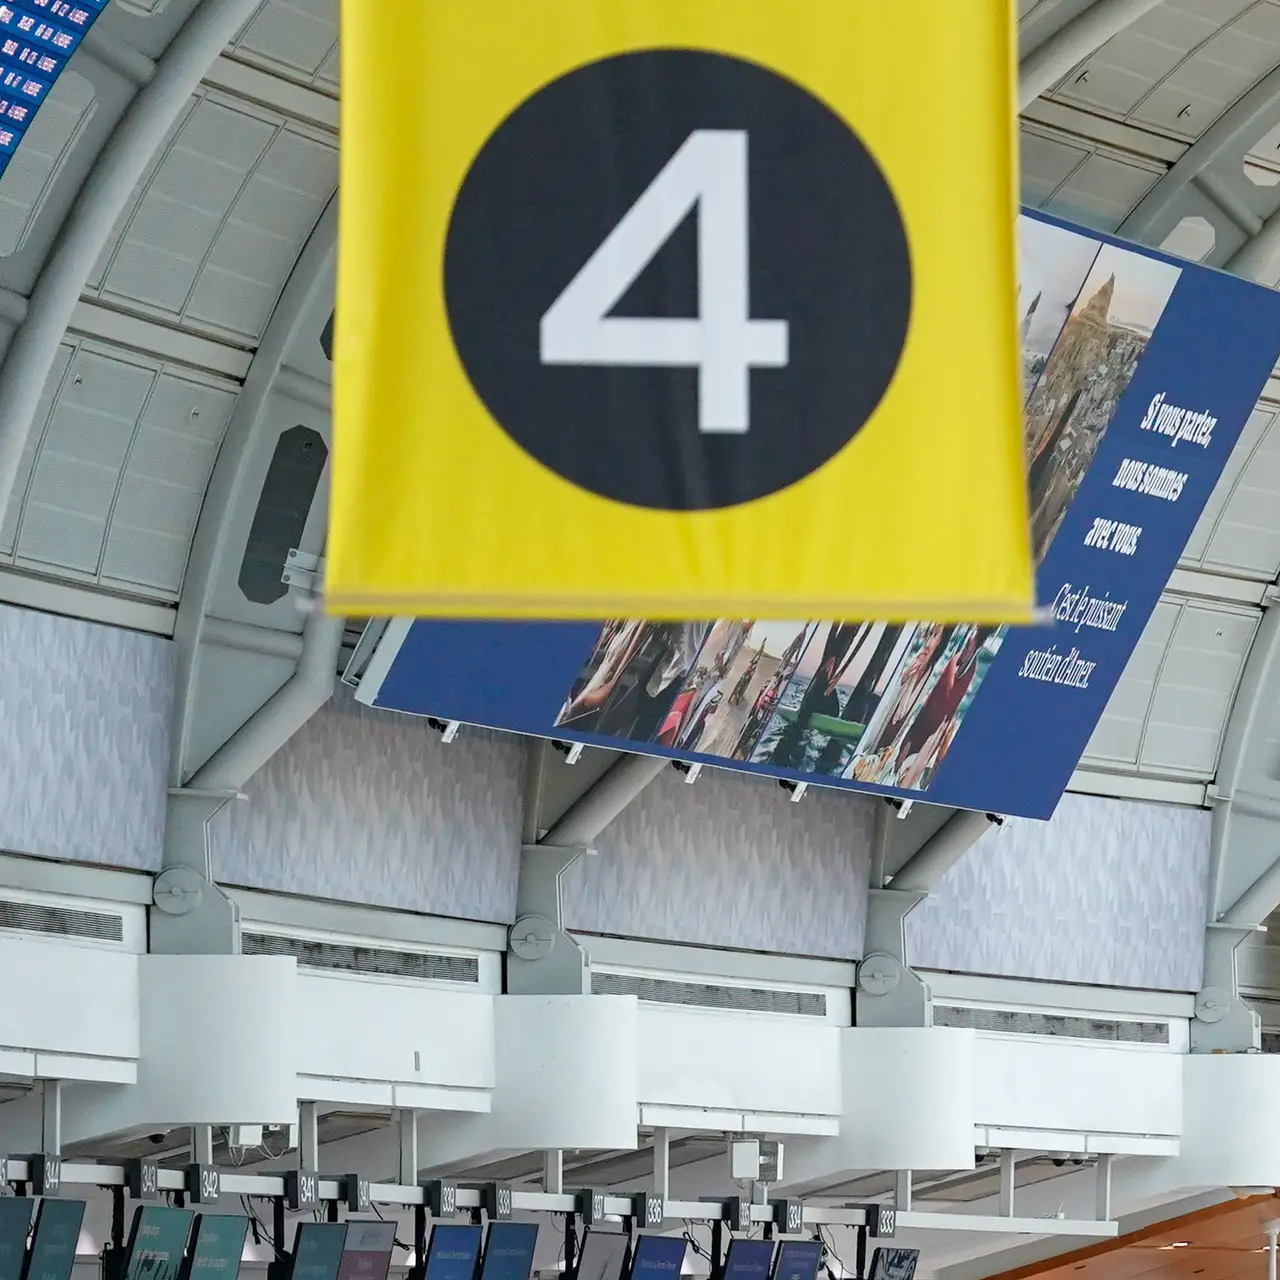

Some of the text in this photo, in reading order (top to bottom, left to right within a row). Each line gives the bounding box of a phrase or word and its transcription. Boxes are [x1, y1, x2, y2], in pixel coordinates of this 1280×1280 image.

[539, 129, 789, 434] 4
[1140, 392, 1218, 449] Si vous partez,
[1112, 458, 1189, 502] nous sommes
[1084, 517, 1118, 549] avec
[1070, 585, 1089, 623] le
[1074, 591, 1128, 633] puissant
[1018, 644, 1062, 682] soutien
[45, 1161, 60, 1189] 344
[142, 1164, 157, 1192] 343
[202, 1171, 218, 1197] 342
[300, 1176, 315, 1202] 341
[442, 1186, 455, 1212] 339
[649, 1198, 662, 1223] 336
[788, 1205, 801, 1229] 334
[880, 1210, 895, 1233] 333
